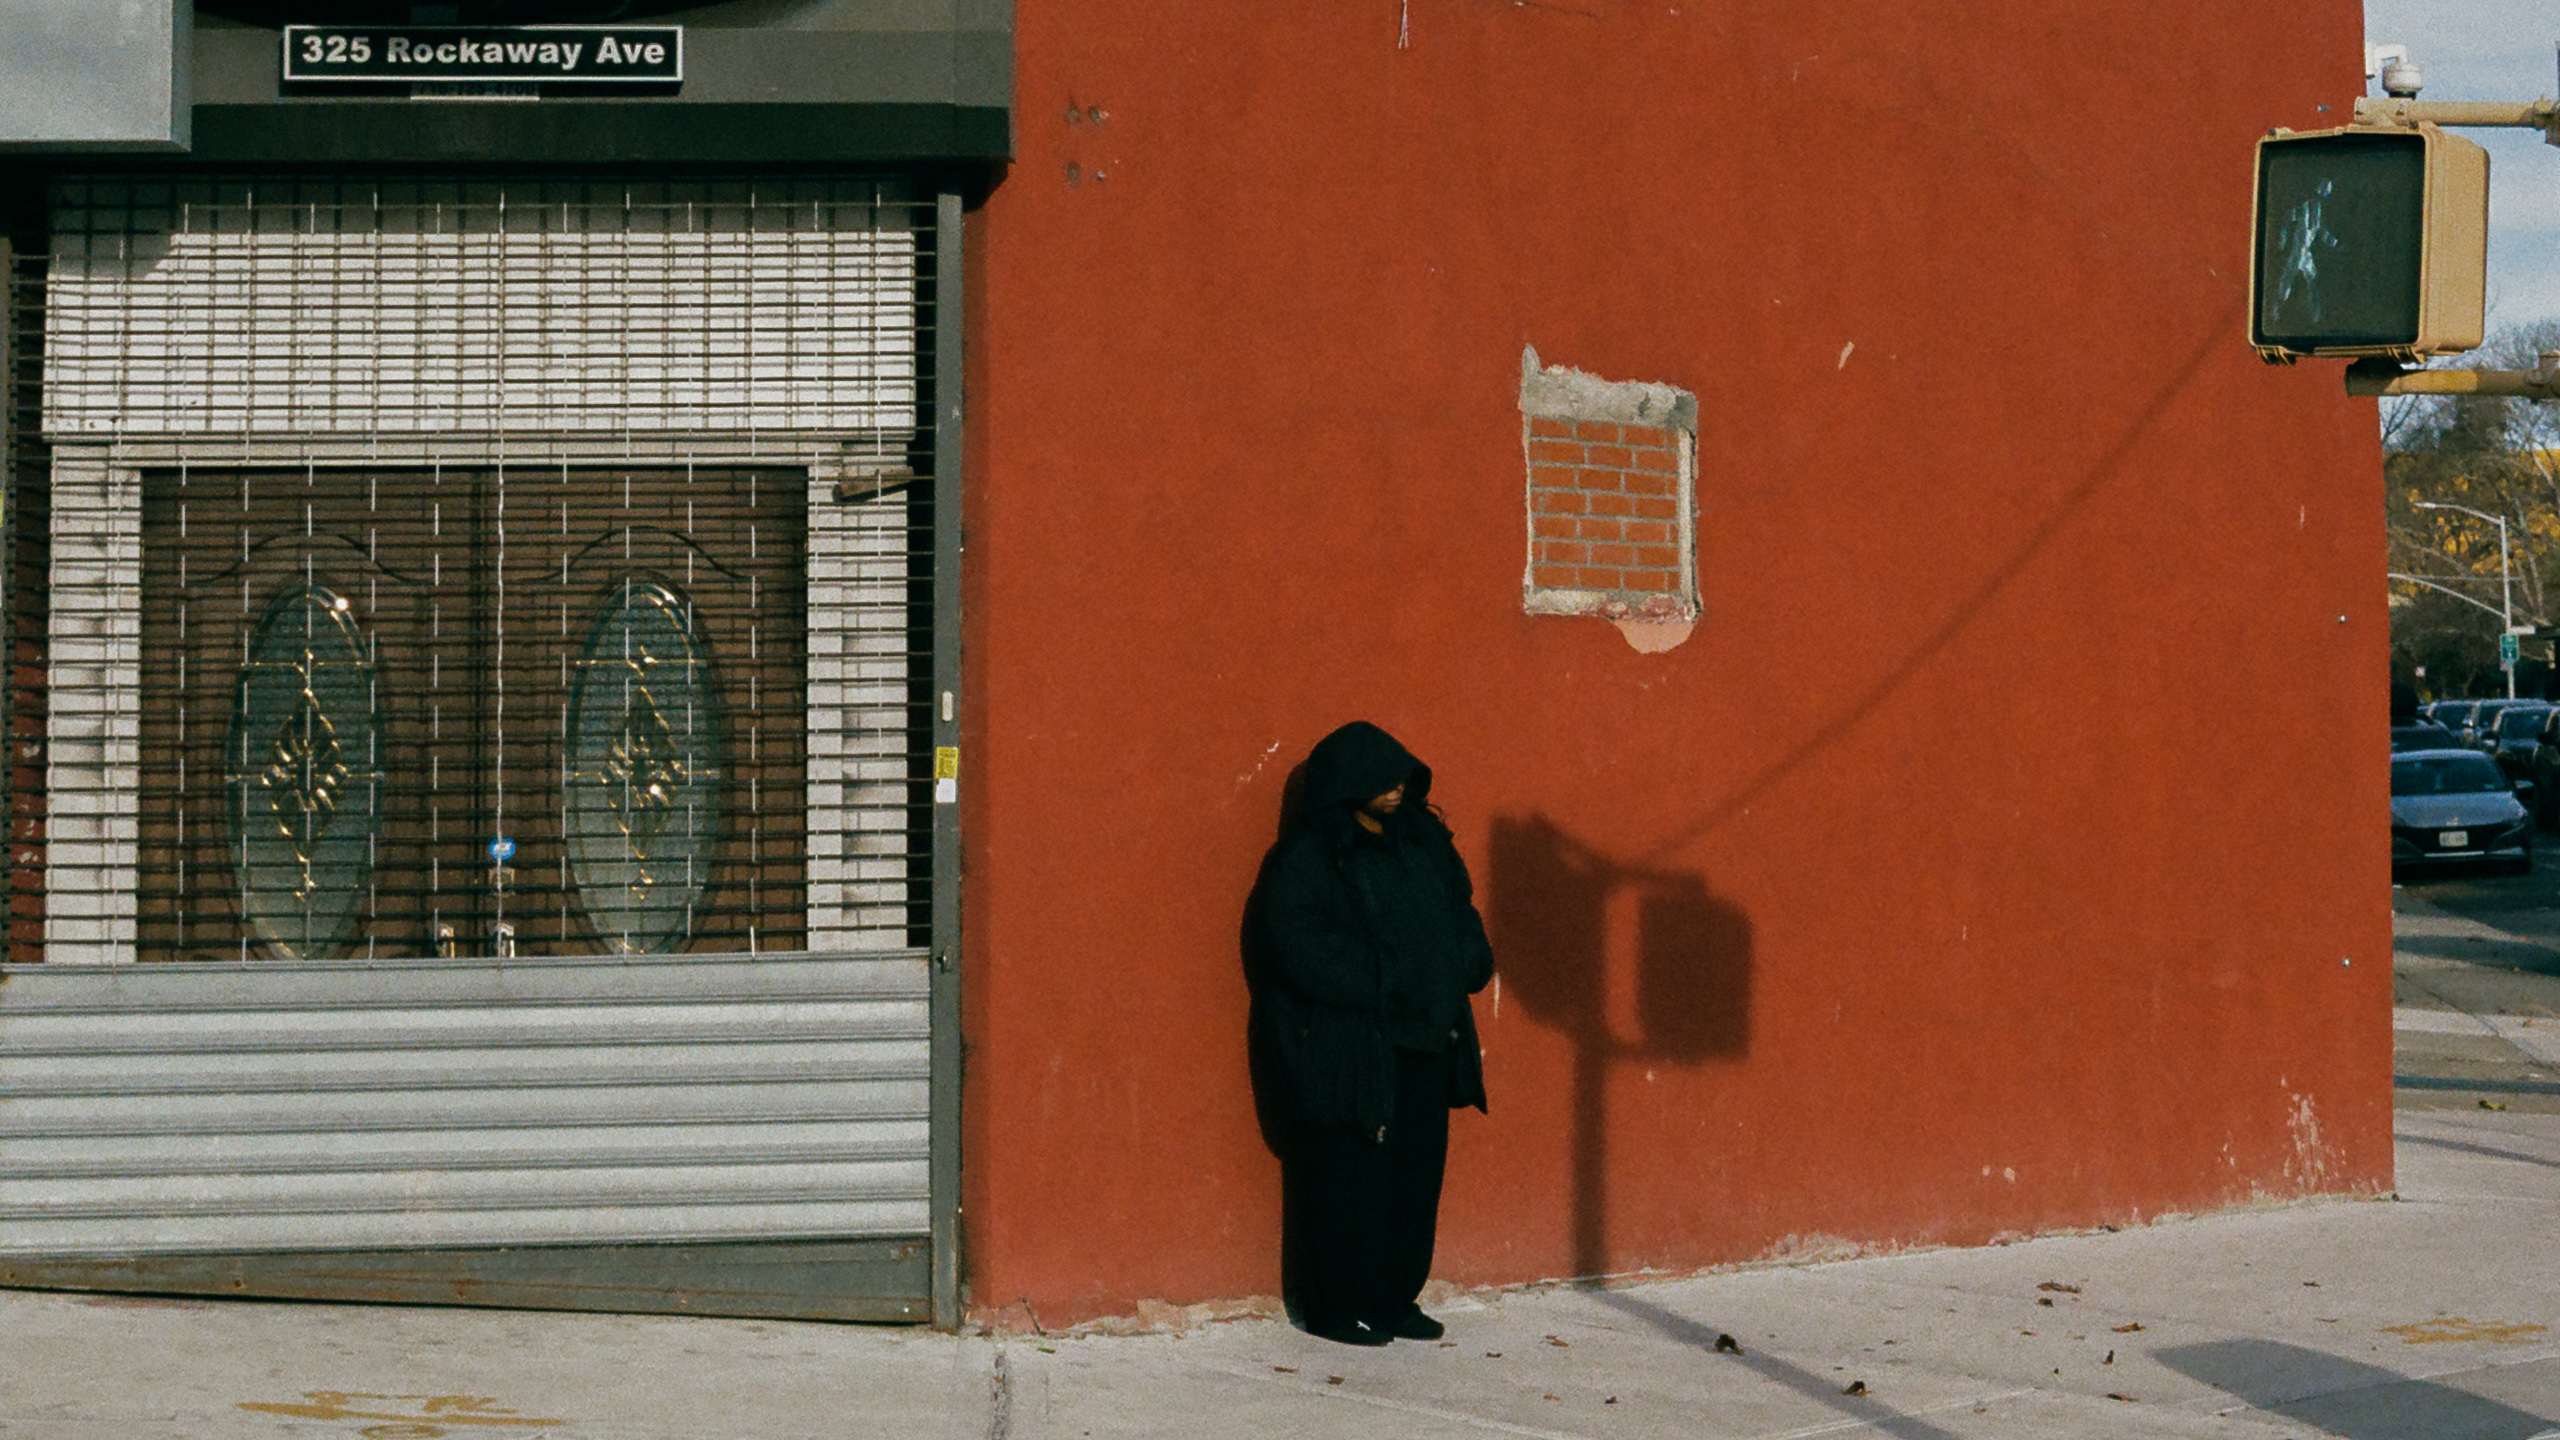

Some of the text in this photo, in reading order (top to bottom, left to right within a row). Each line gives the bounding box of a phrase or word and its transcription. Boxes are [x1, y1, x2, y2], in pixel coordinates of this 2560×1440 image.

[302, 36, 665, 70] 325 Rockaway Ave
